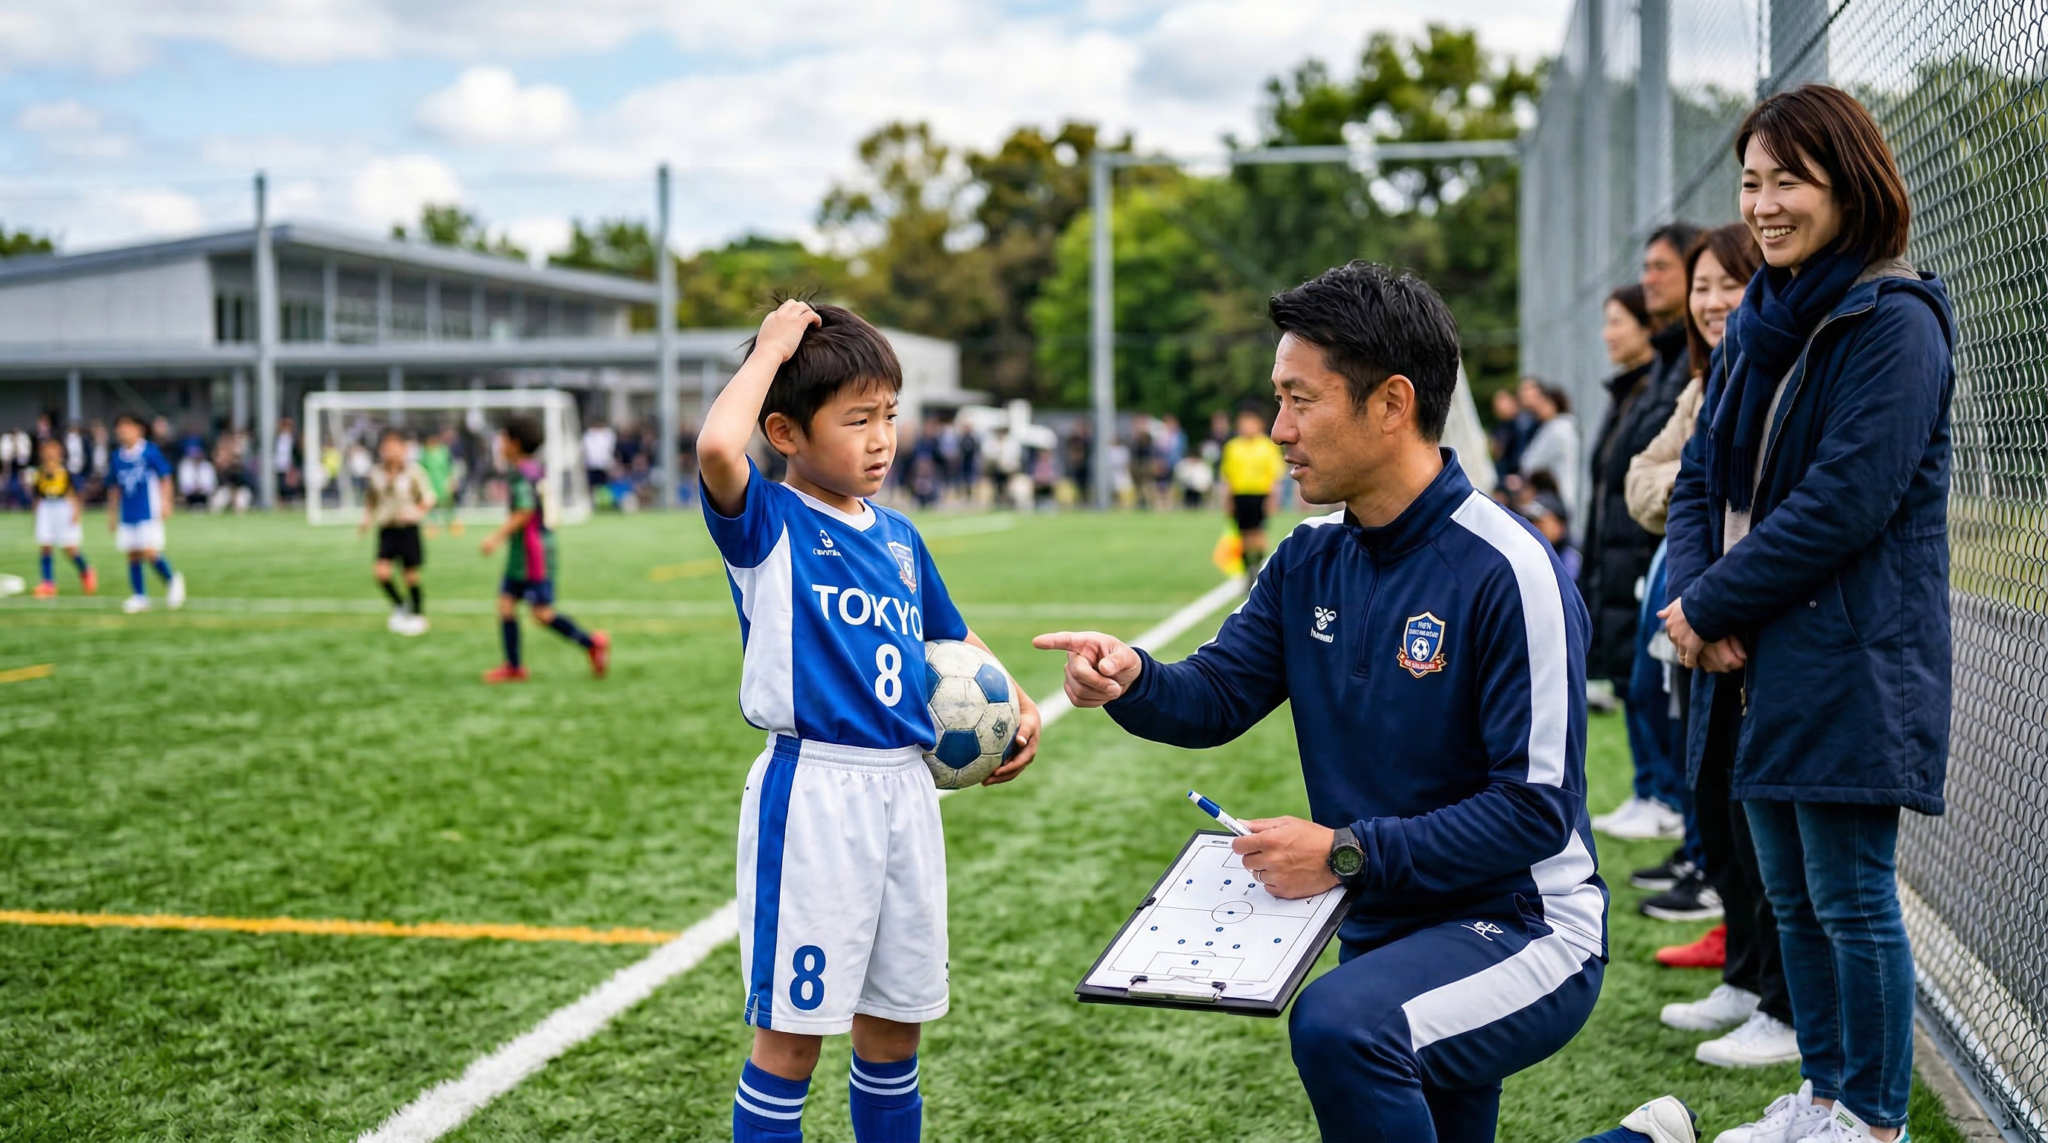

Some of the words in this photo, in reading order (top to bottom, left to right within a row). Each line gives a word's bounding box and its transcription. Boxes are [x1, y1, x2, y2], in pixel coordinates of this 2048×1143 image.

[811, 584, 924, 642] TOKYO
[875, 643, 903, 708] 8
[789, 944, 827, 1011] 8
